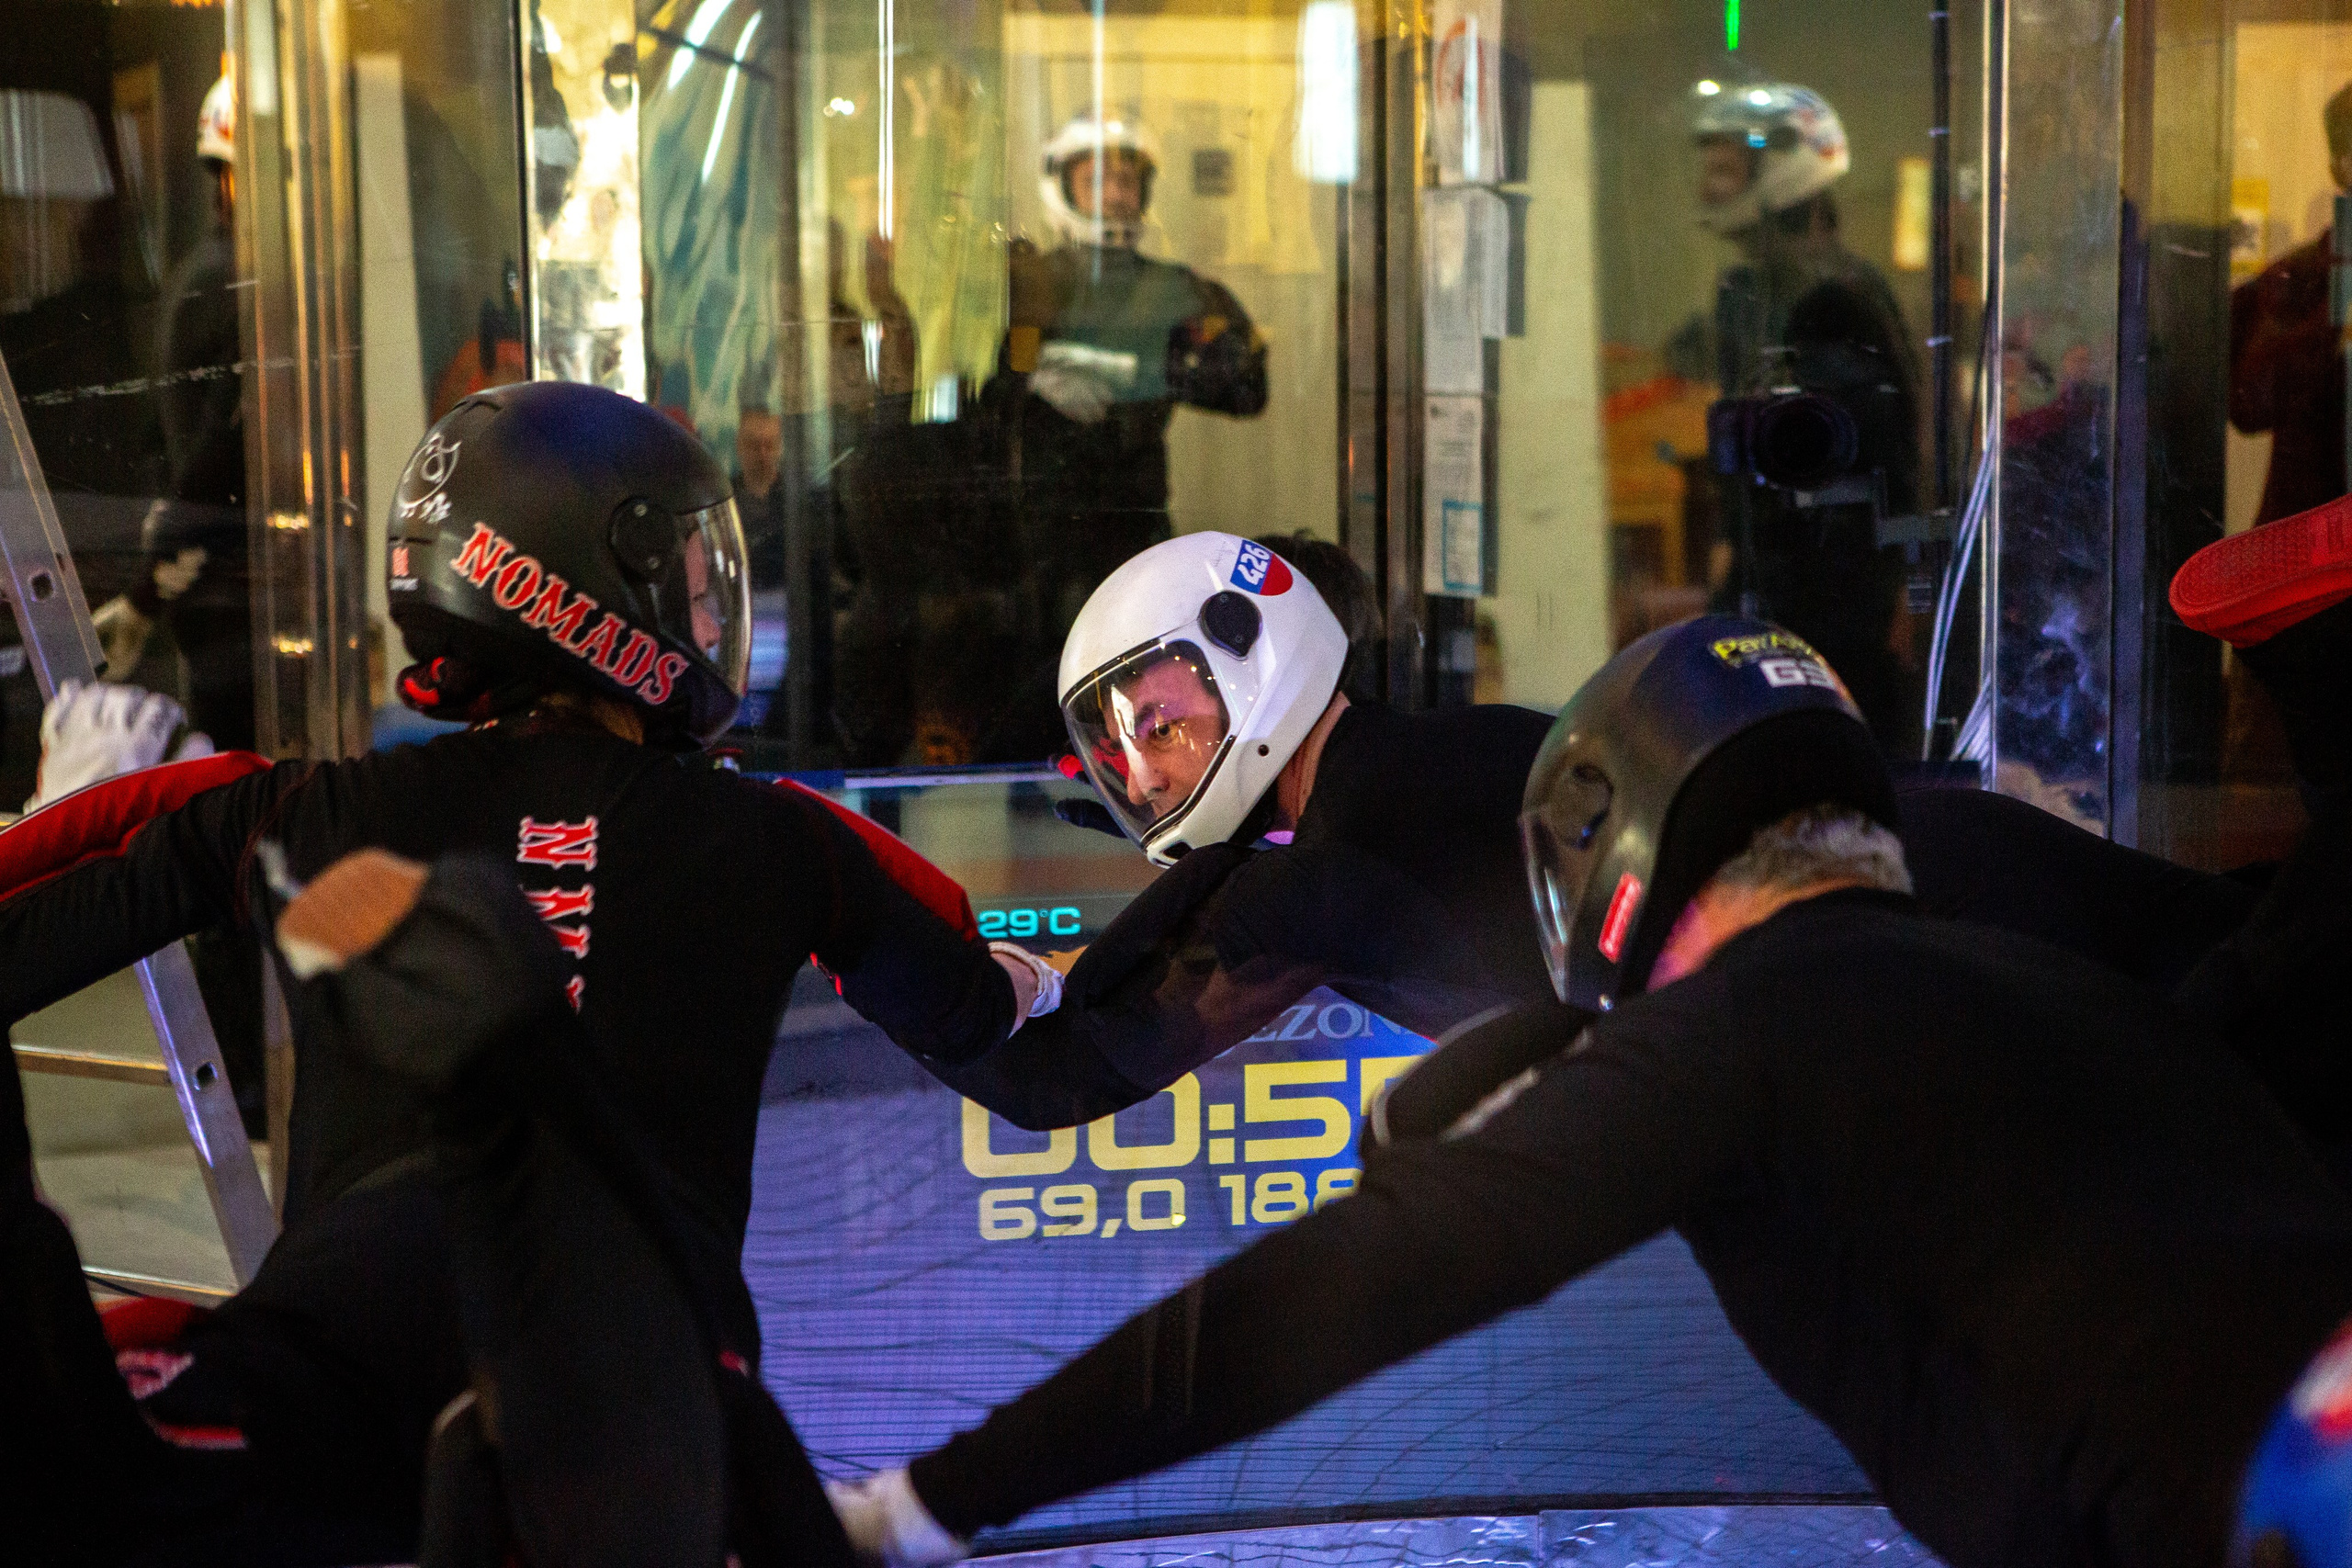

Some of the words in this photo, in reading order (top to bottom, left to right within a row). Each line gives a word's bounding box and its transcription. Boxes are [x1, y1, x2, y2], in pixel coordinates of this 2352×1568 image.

[450, 522, 690, 705] NOMADS
[978, 906, 1081, 938] 29°C
[978, 1178, 1186, 1240] 69,0
